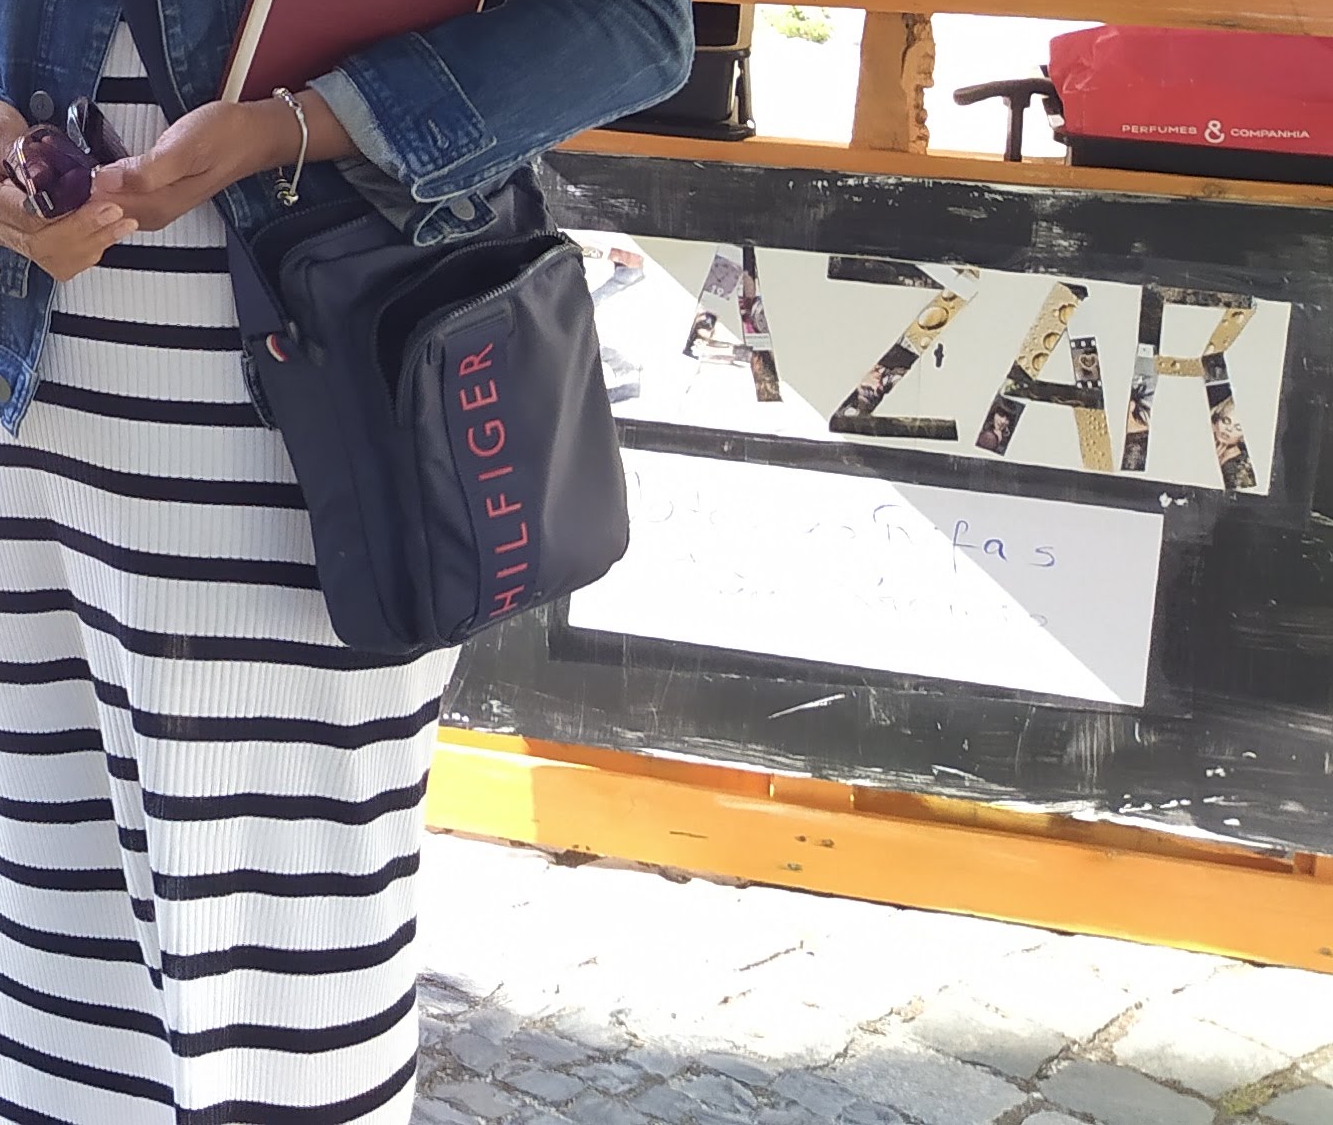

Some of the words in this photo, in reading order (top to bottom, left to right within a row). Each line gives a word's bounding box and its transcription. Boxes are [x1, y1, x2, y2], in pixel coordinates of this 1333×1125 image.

[1121, 123, 1198, 136] PERFUMES
[1204, 119, 1227, 143] &
[1230, 127, 1312, 140] COMPANHIA
[456, 341, 530, 618] HILFIGER
